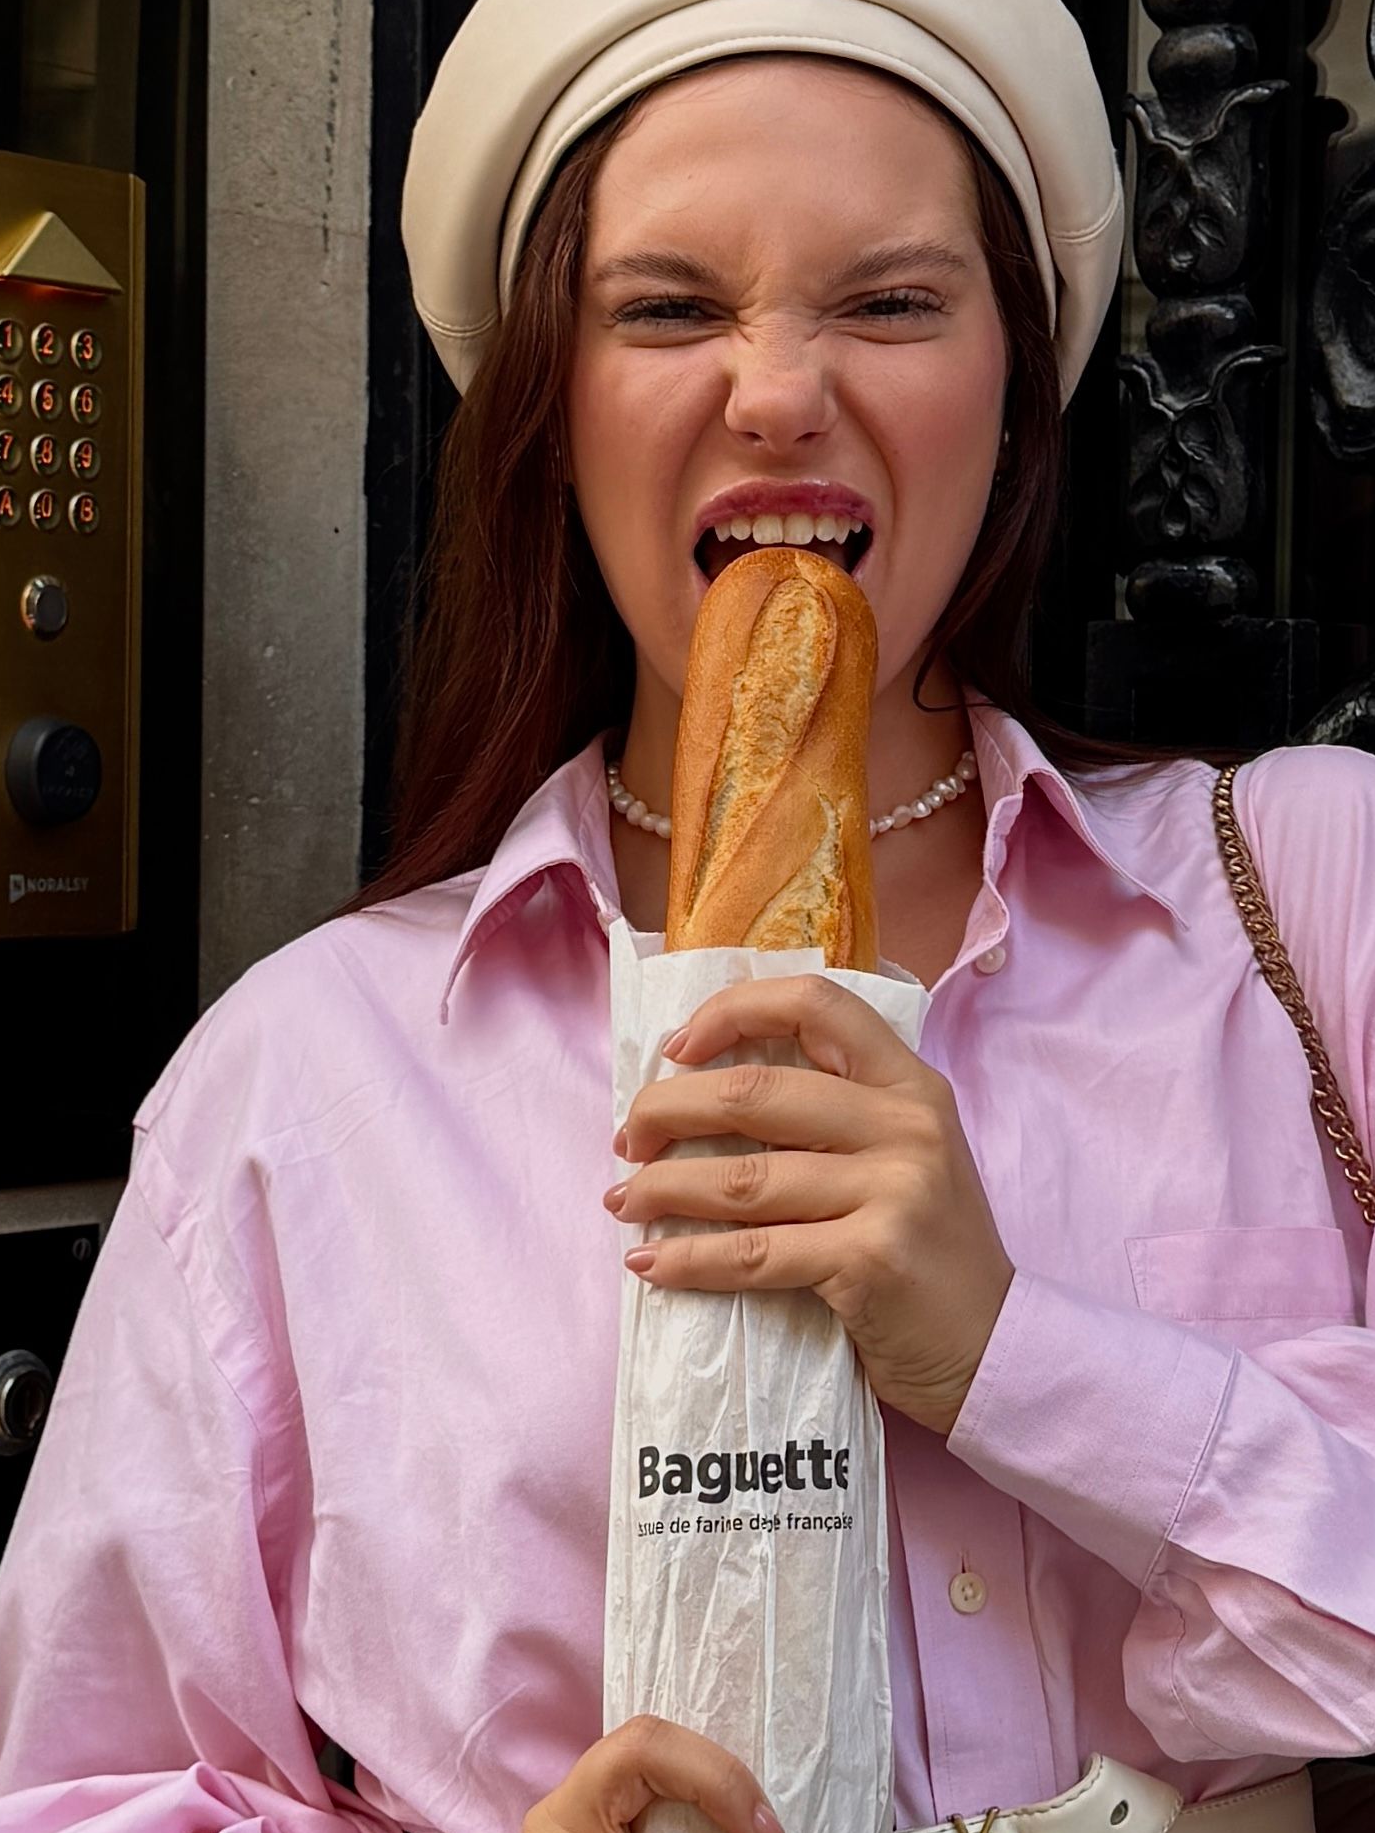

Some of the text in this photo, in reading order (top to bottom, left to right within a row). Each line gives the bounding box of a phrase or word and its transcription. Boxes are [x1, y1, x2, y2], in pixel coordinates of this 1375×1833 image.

[3, 323, 94, 360] 1 2 3
[0, 378, 94, 414] 4 5 6
[1, 434, 94, 469] 7 8 9
[0, 490, 15, 517] A
[40, 493, 53, 519] 0
[26, 876, 90, 893] NORALSY
[639, 1439, 850, 1504] Baguette
[669, 1517, 691, 1534] de
[696, 1515, 743, 1534] farine
